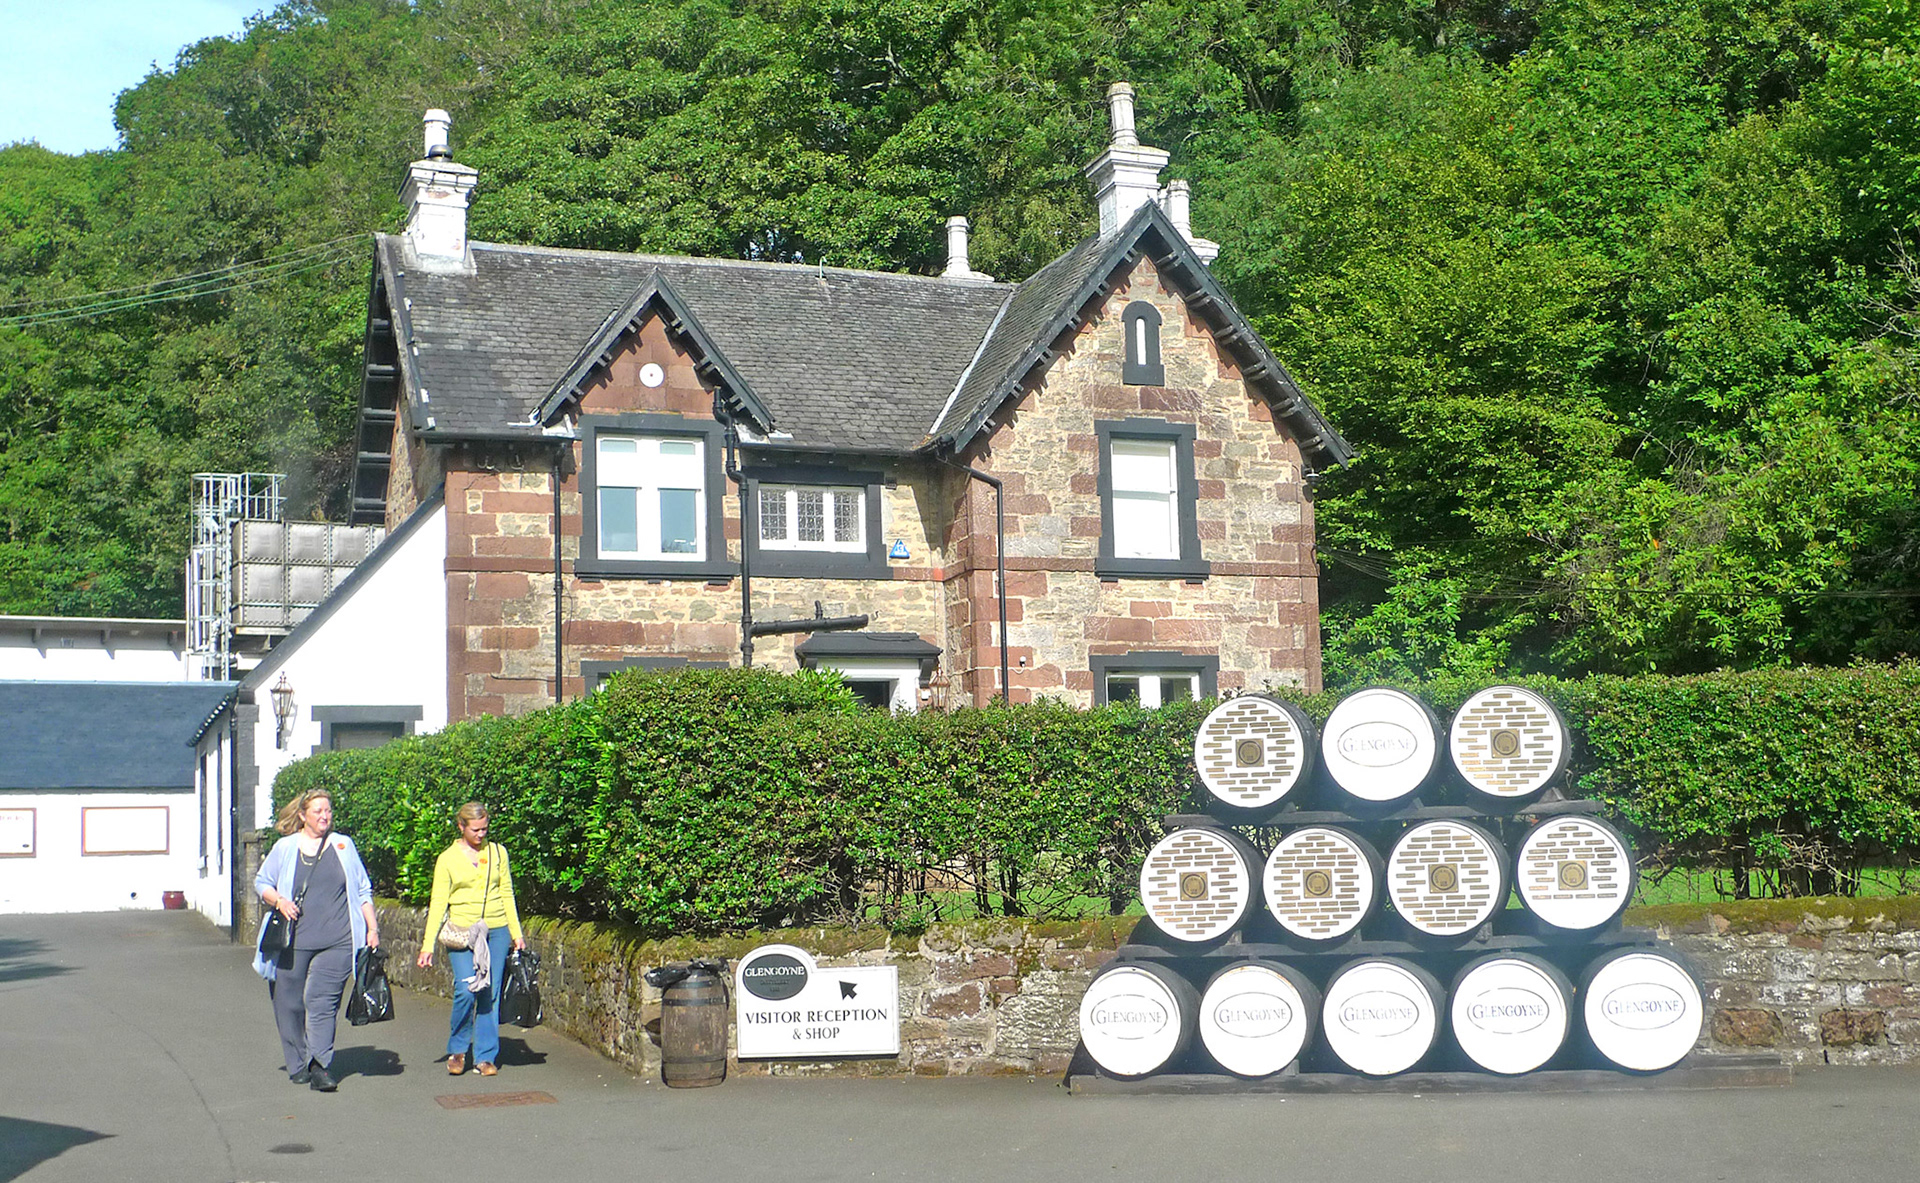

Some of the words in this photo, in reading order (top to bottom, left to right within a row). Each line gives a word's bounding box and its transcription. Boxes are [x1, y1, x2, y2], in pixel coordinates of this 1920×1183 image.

[1342, 737, 1411, 752] GENGONE
[744, 966, 805, 977] GLENGOYNE
[745, 1011, 801, 1024] VISITOR
[807, 1008, 888, 1023] RECEPTION
[1096, 1009, 1162, 1024] GLENGOYNE
[1343, 1006, 1413, 1021] GLENGOYNE
[1472, 1003, 1544, 1019] GLENGOYNE
[792, 1028, 802, 1040] &
[806, 1027, 840, 1039] SHOP
